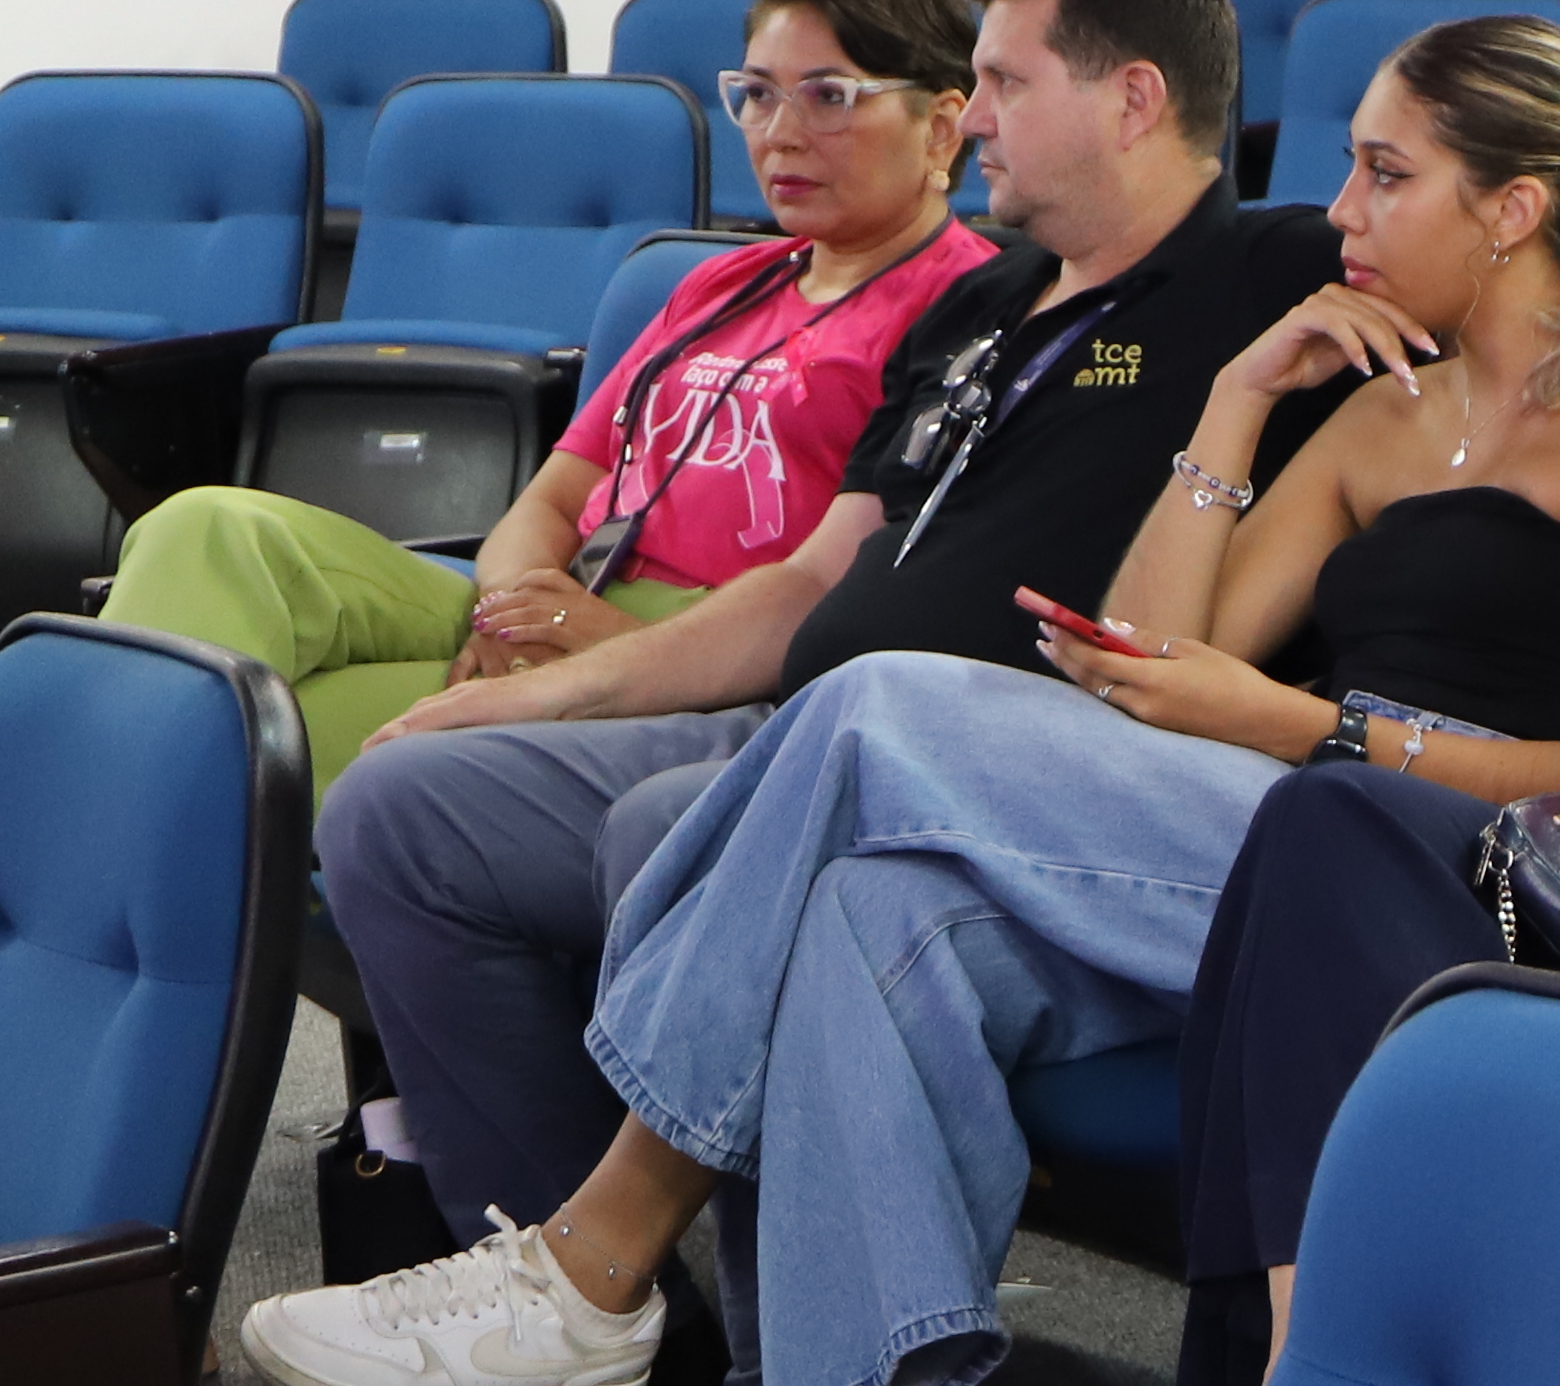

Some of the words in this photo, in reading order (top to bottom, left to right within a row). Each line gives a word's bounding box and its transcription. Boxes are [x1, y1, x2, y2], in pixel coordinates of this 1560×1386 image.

[1092, 338, 1142, 363] tce
[681, 365, 718, 389] laço
[754, 376, 769, 393] a
[1095, 364, 1140, 386] mt
